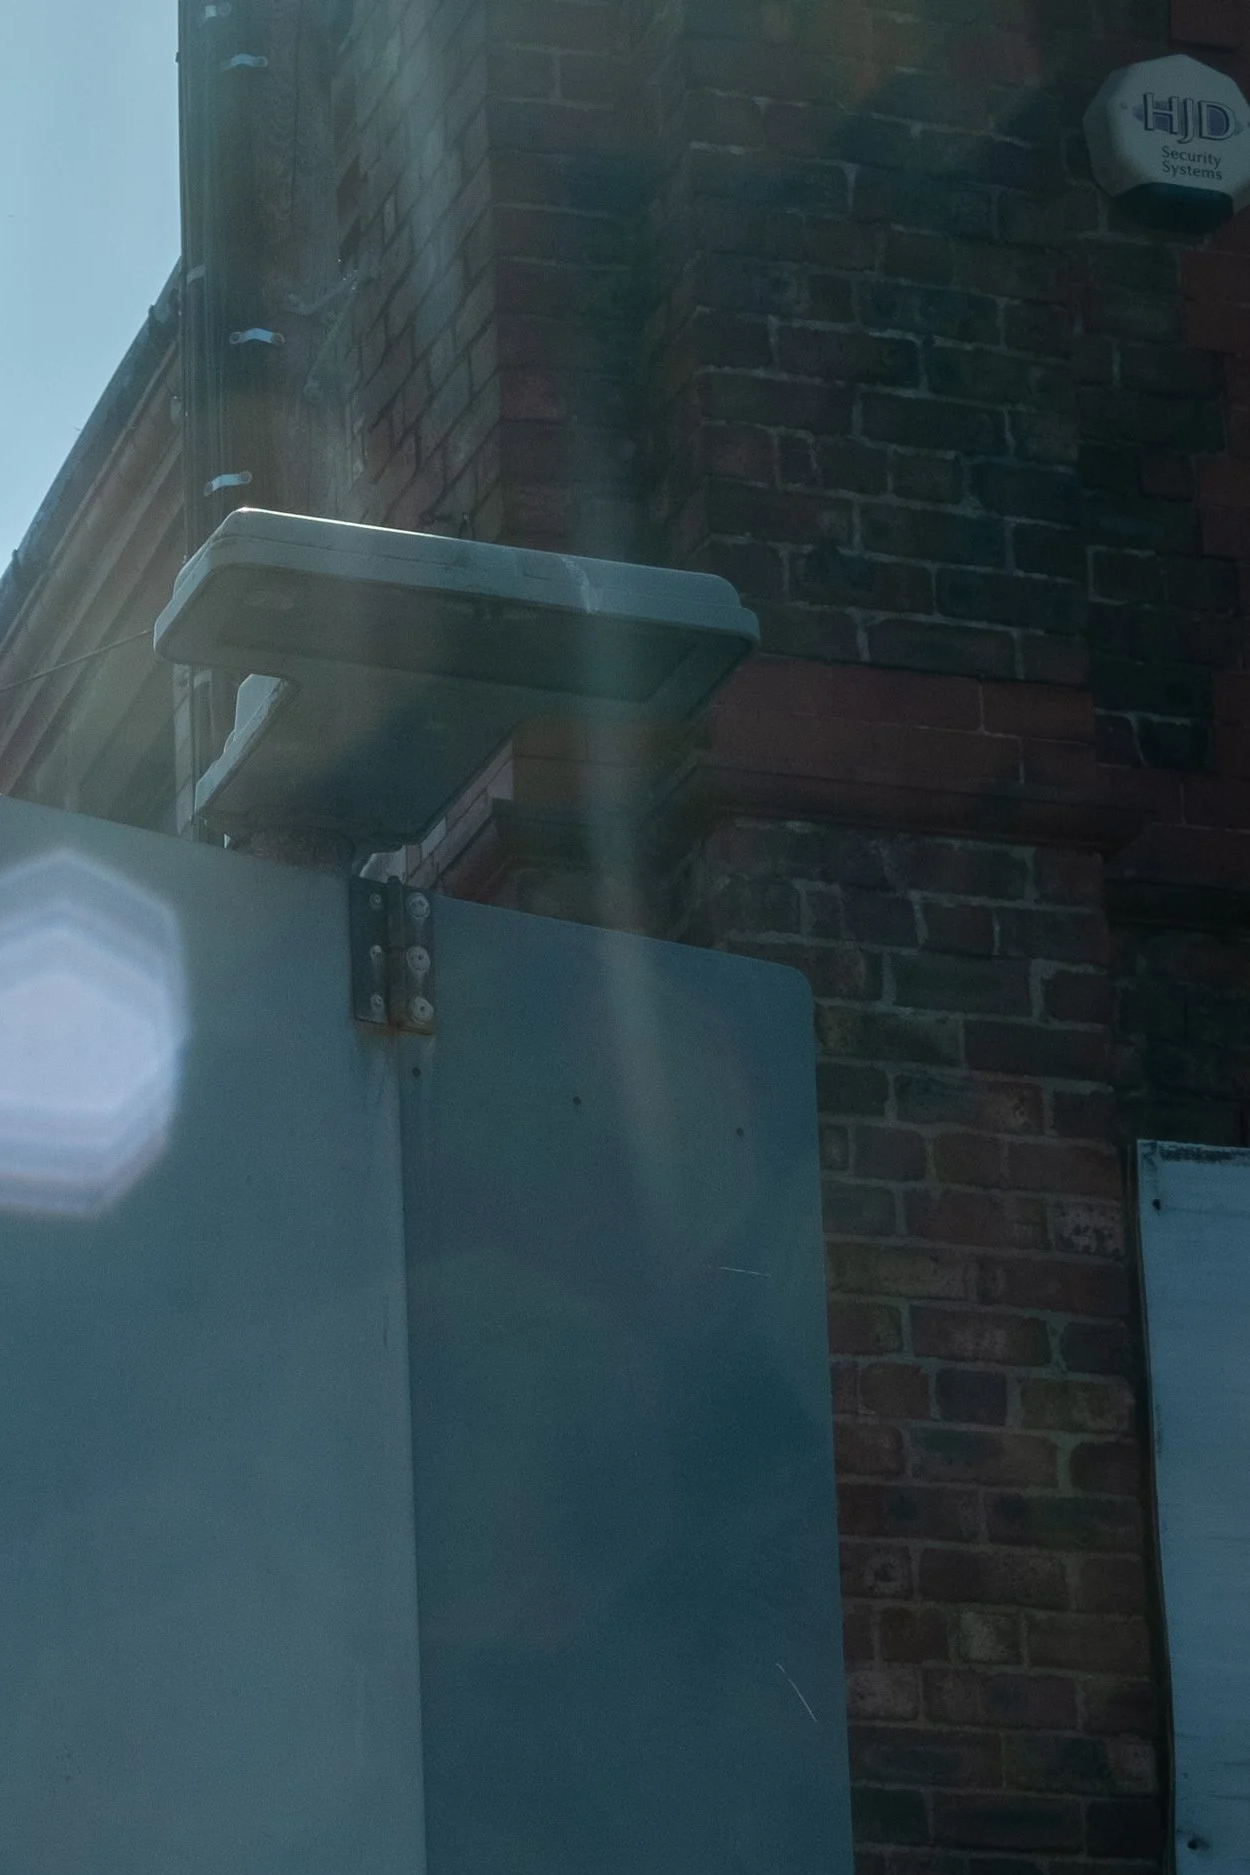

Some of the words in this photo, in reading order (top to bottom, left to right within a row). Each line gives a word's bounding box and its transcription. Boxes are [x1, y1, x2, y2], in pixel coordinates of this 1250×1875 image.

[1143, 92, 1236, 144] HJD
[1162, 145, 1222, 168] Security
[1162, 161, 1222, 180] Systems
